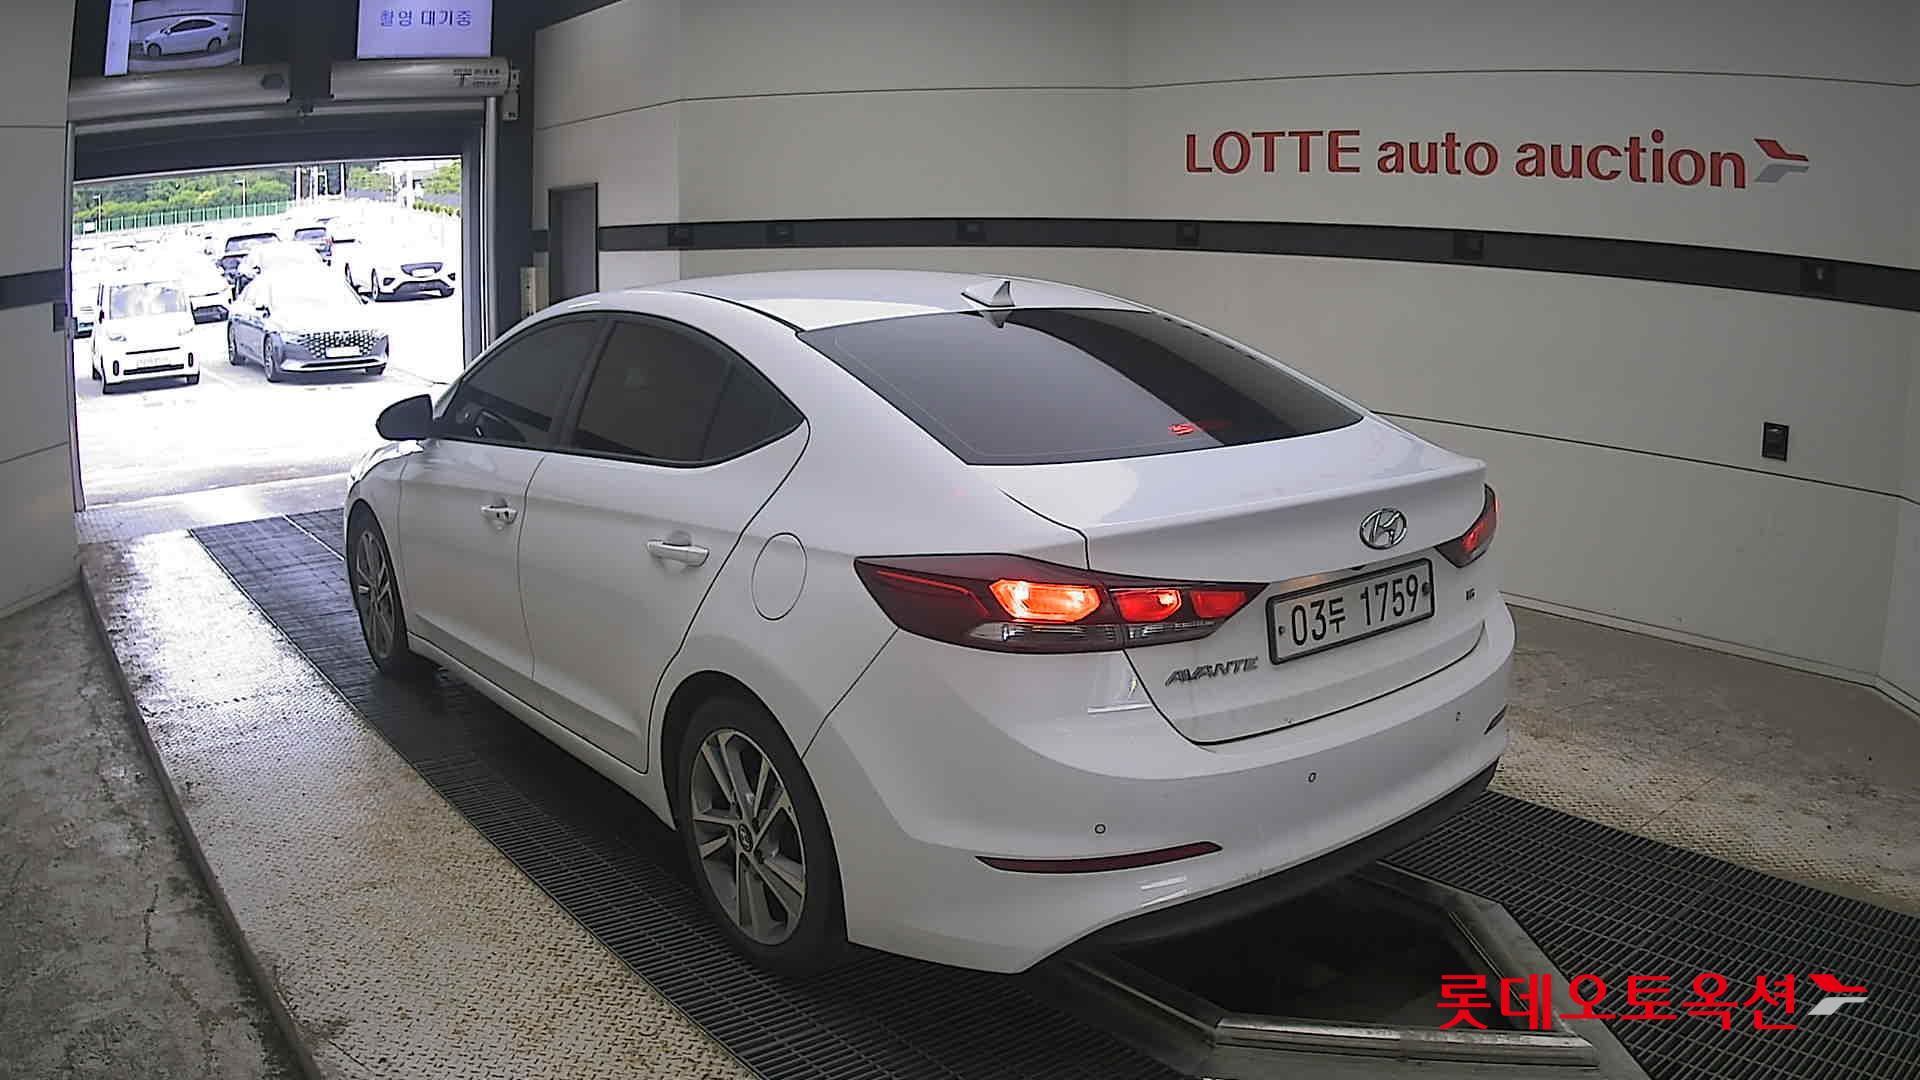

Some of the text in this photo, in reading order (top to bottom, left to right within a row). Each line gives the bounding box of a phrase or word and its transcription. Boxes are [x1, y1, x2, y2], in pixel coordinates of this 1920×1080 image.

[421, 10, 471, 26] 대기중
[1185, 129, 1746, 188] LOTTE auto auction
[1291, 574, 1418, 646] 03두 1759
[1165, 656, 1258, 687] AVANTE
